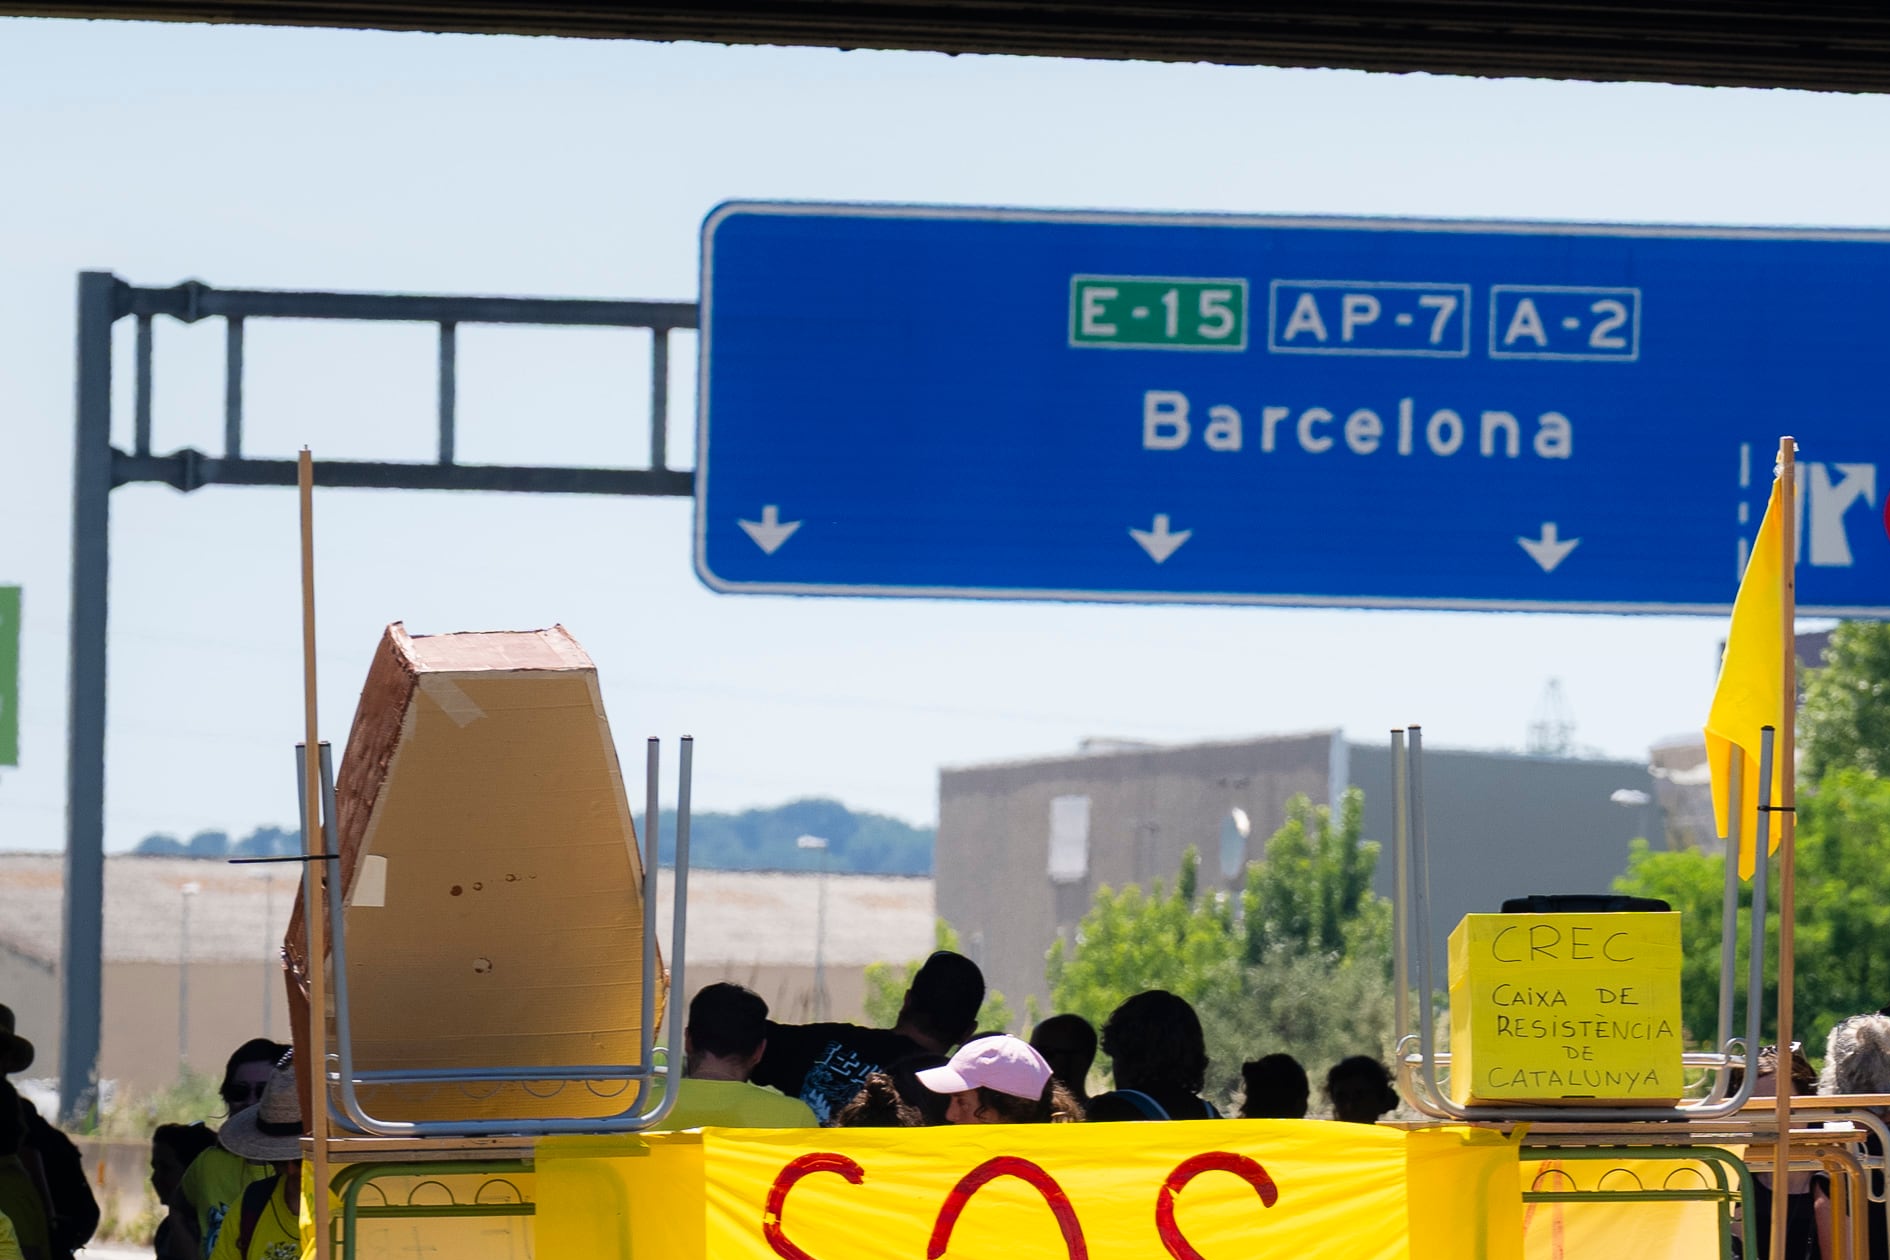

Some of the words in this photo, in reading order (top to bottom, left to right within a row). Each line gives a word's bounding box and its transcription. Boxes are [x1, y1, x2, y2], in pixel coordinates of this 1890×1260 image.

[1081, 287, 1234, 339] E-15
[1283, 293, 1457, 344] AP-7
[1503, 298, 1628, 348] A-2
[1143, 390, 1573, 460] Barcelona
[1492, 924, 1634, 962] CREC
[1595, 987, 1639, 1005] DE
[1561, 1045, 1594, 1061] DE
[1488, 1067, 1660, 1093] CATALUNYA
